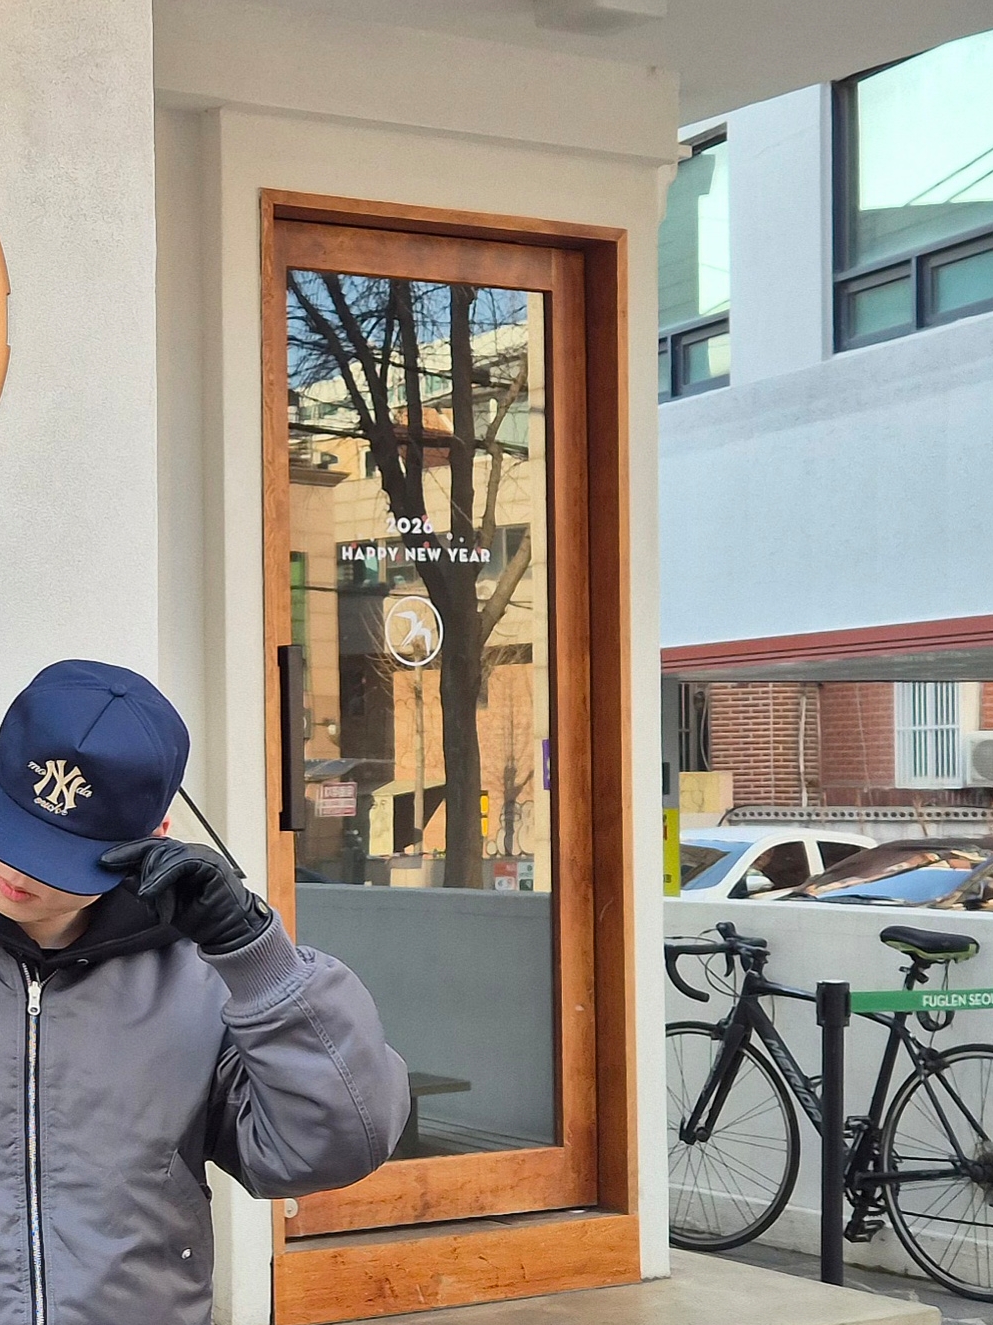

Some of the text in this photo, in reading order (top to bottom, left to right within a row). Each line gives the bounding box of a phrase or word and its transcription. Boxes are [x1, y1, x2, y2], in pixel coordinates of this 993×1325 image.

[386, 517, 434, 534] 2026
[341, 546, 491, 563] HAPPY NEW YEAR
[922, 994, 967, 1008] FUGLEN
[764, 1038, 823, 1123] MERIDA
